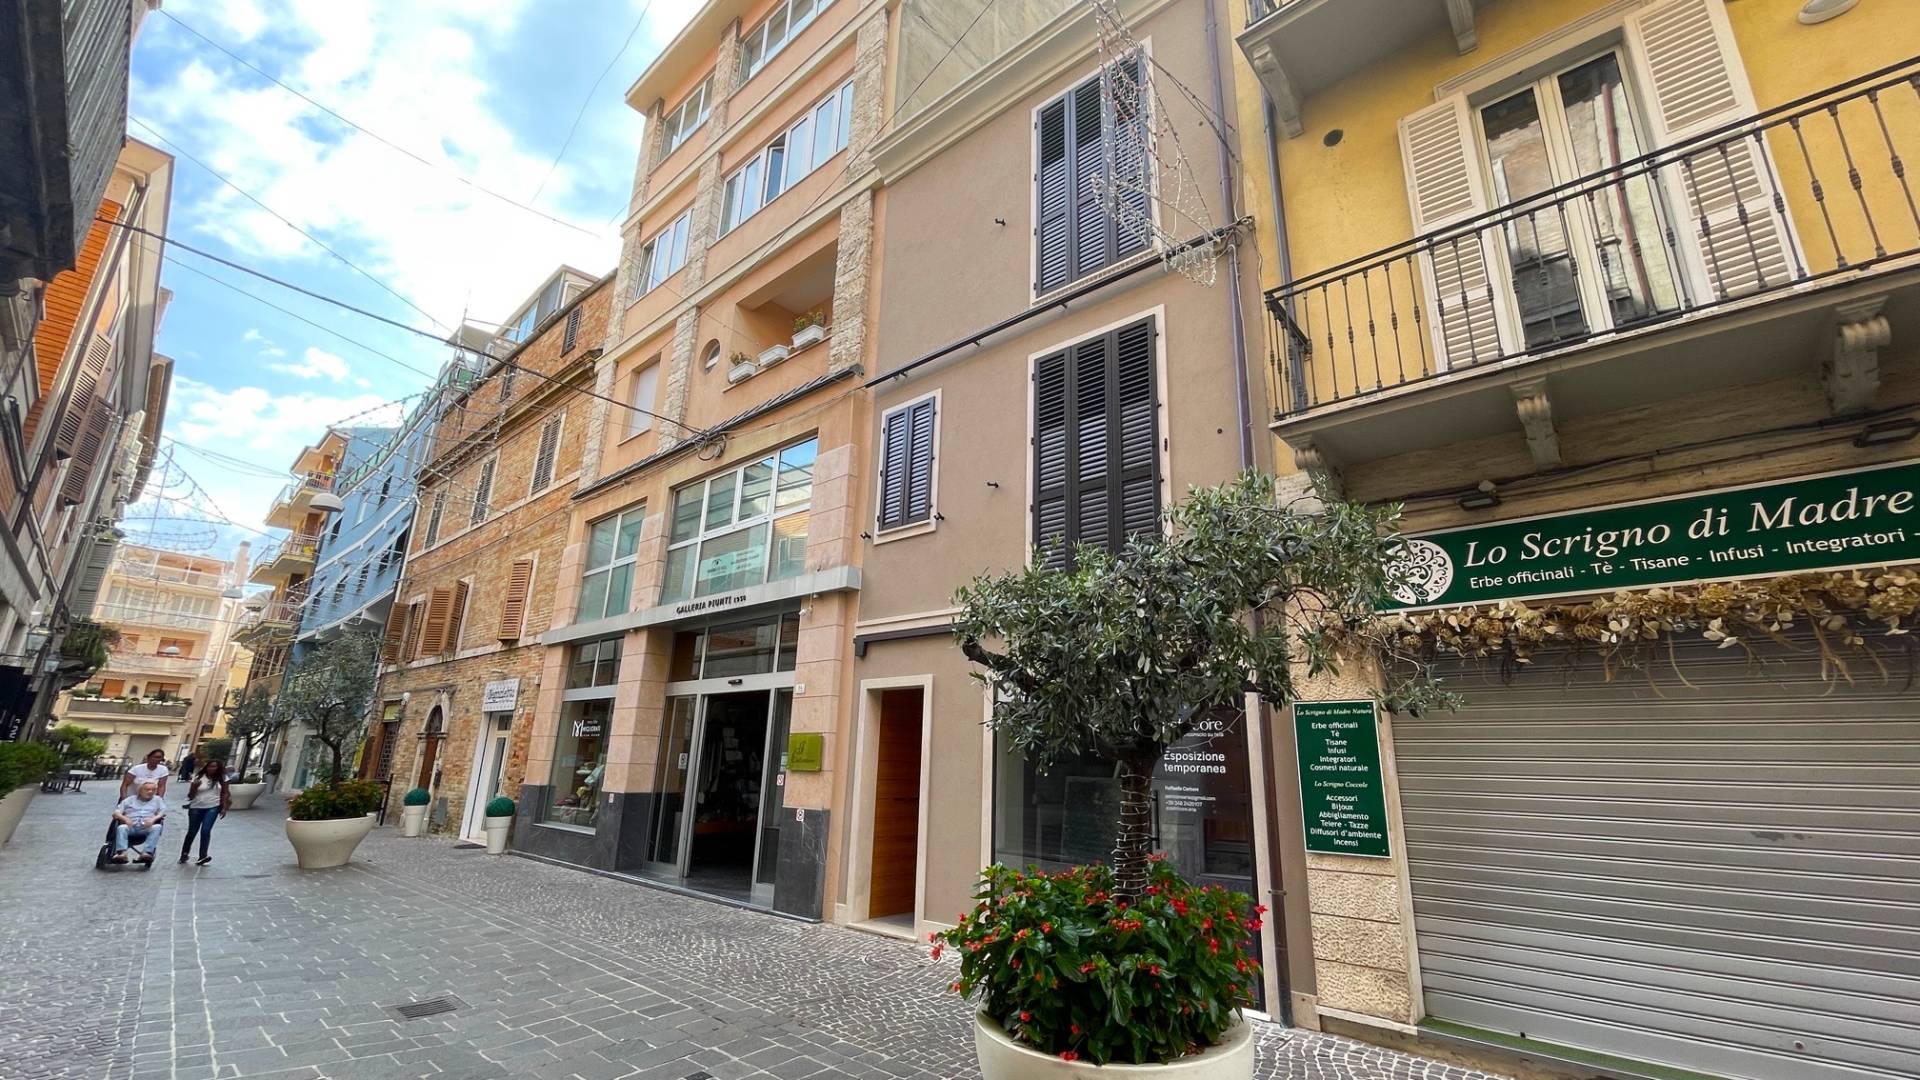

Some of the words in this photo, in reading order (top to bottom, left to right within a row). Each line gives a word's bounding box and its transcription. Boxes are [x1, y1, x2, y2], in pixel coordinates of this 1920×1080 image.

[1464, 541, 1507, 568] Lo
[1520, 524, 1671, 561] Scrigno
[1688, 507, 1730, 540] di
[1747, 487, 1914, 532] Madre
[1470, 574, 1503, 589] Erbe
[1507, 565, 1574, 586] officinali
[1590, 560, 1613, 575] Tè
[1629, 554, 1690, 571] Tisane
[1709, 543, 1764, 563] Infusi
[1786, 528, 1905, 554] Integratori
[676, 601, 706, 615] GALLERIA
[1328, 721, 1358, 729] officinali
[1325, 738, 1348, 746] Tisane
[1163, 751, 1226, 762] Esposizione
[1319, 756, 1357, 764] Integratori
[1163, 763, 1227, 774] temporanea
[1309, 764, 1338, 772] Cosmesi
[1325, 794, 1359, 802] Accessori
[1331, 803, 1354, 811] Bijoux
[1319, 811, 1370, 820] Abbigliamento
[1320, 820, 1342, 828] Teiere
[1348, 821, 1369, 829] Tazze
[1310, 828, 1339, 836] Diffusori
[1340, 830, 1382, 839] d'ambiente
[1333, 838, 1359, 847] Incensi
